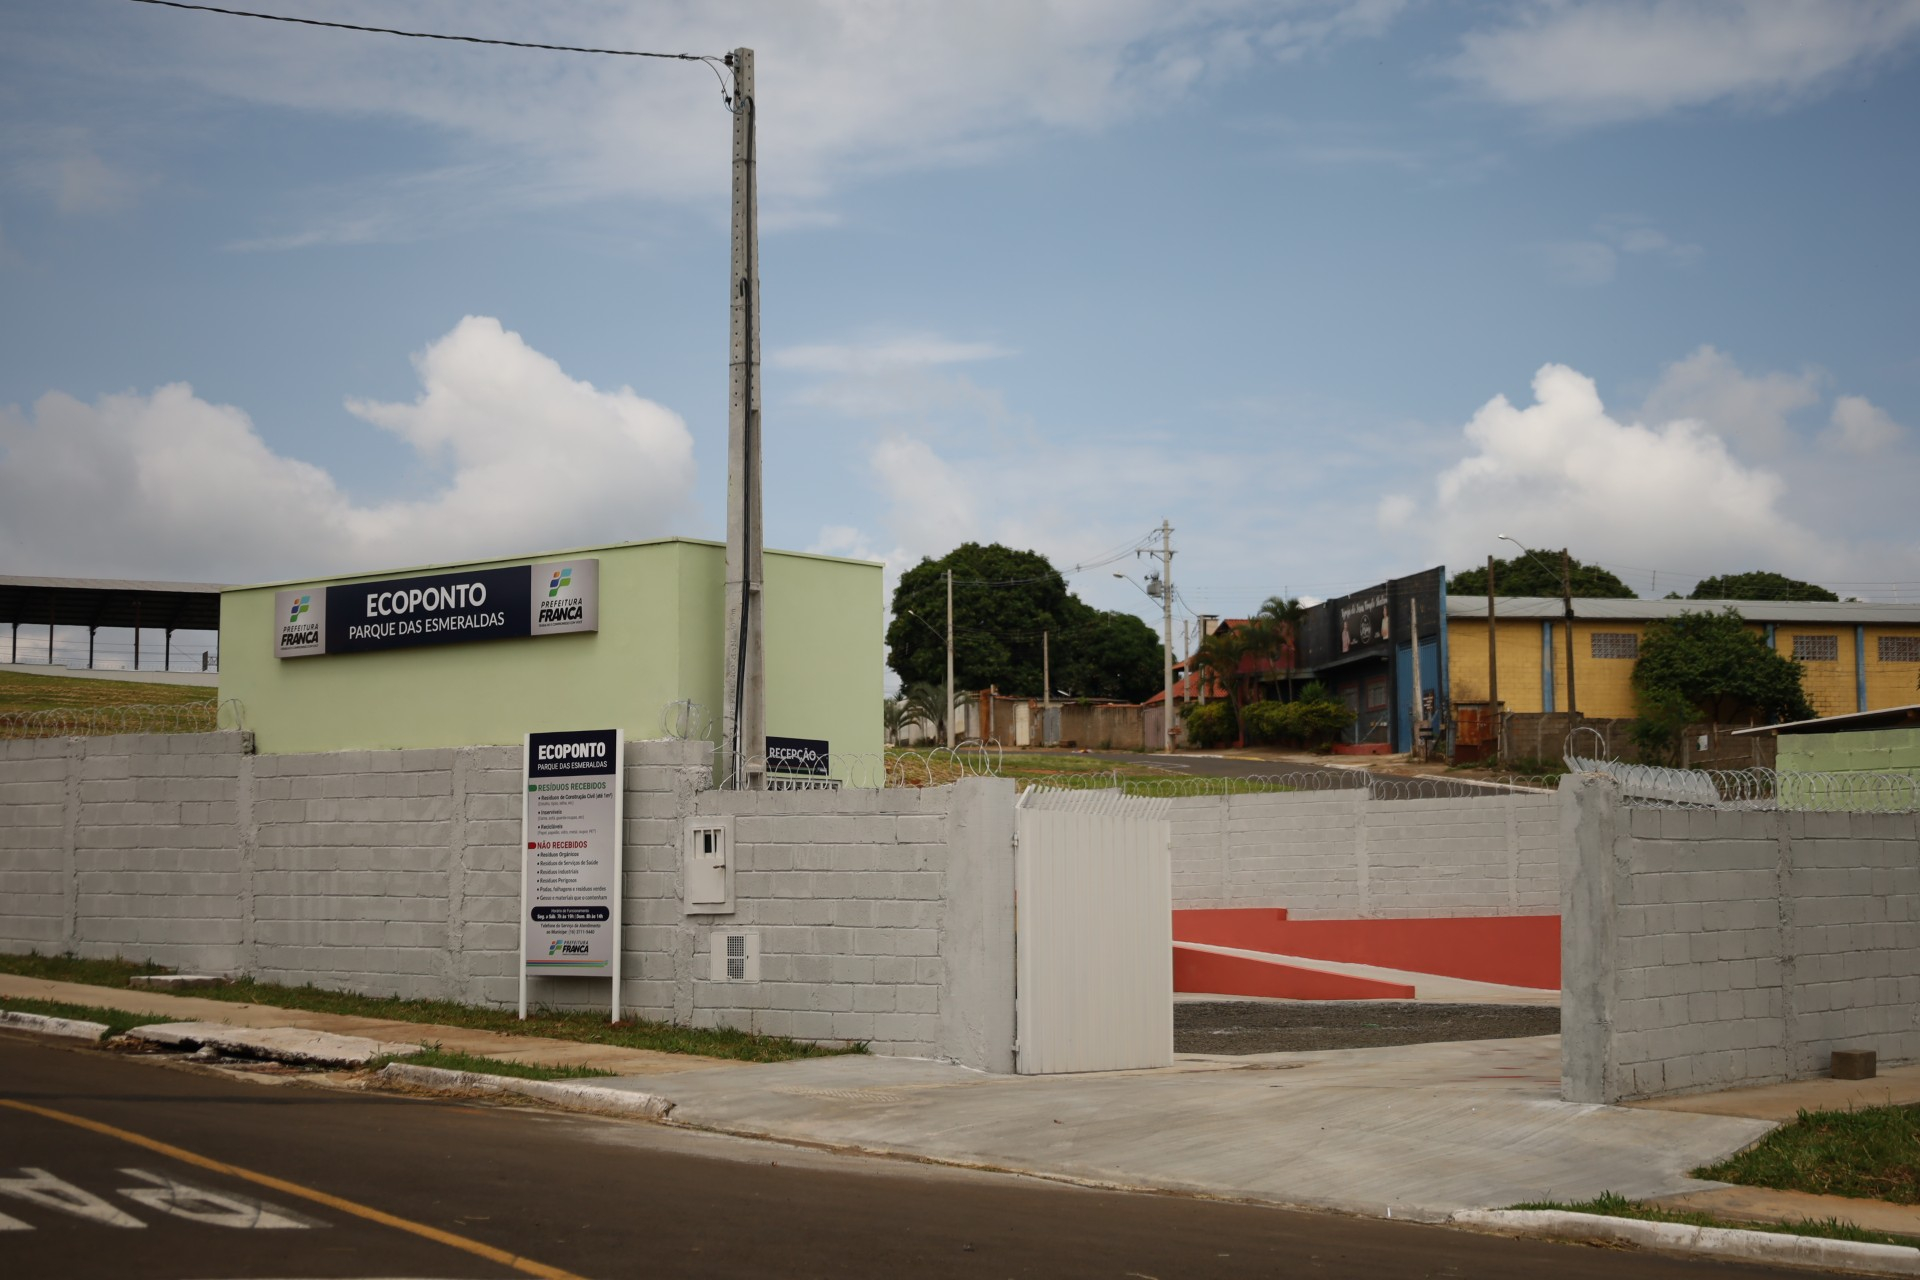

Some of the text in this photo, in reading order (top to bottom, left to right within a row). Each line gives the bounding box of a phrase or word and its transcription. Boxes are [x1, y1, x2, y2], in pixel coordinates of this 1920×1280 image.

[366, 582, 486, 617] ECOPONTO
[541, 598, 582, 608] PREFEITURA
[539, 606, 582, 622] FRANCA
[283, 624, 318, 632] PREFEITURA
[349, 612, 504, 640] PARQUE DAS ESMERALDAS
[281, 631, 318, 646] FRANCA
[538, 742, 605, 760] ECOPONTO
[769, 747, 816, 762] RECEPÇÃO
[571, 761, 607, 769] ESMERALDAS
[538, 782, 606, 791] RESÍDUOS RECEBIDOS
[538, 841, 551, 849] NÃO
